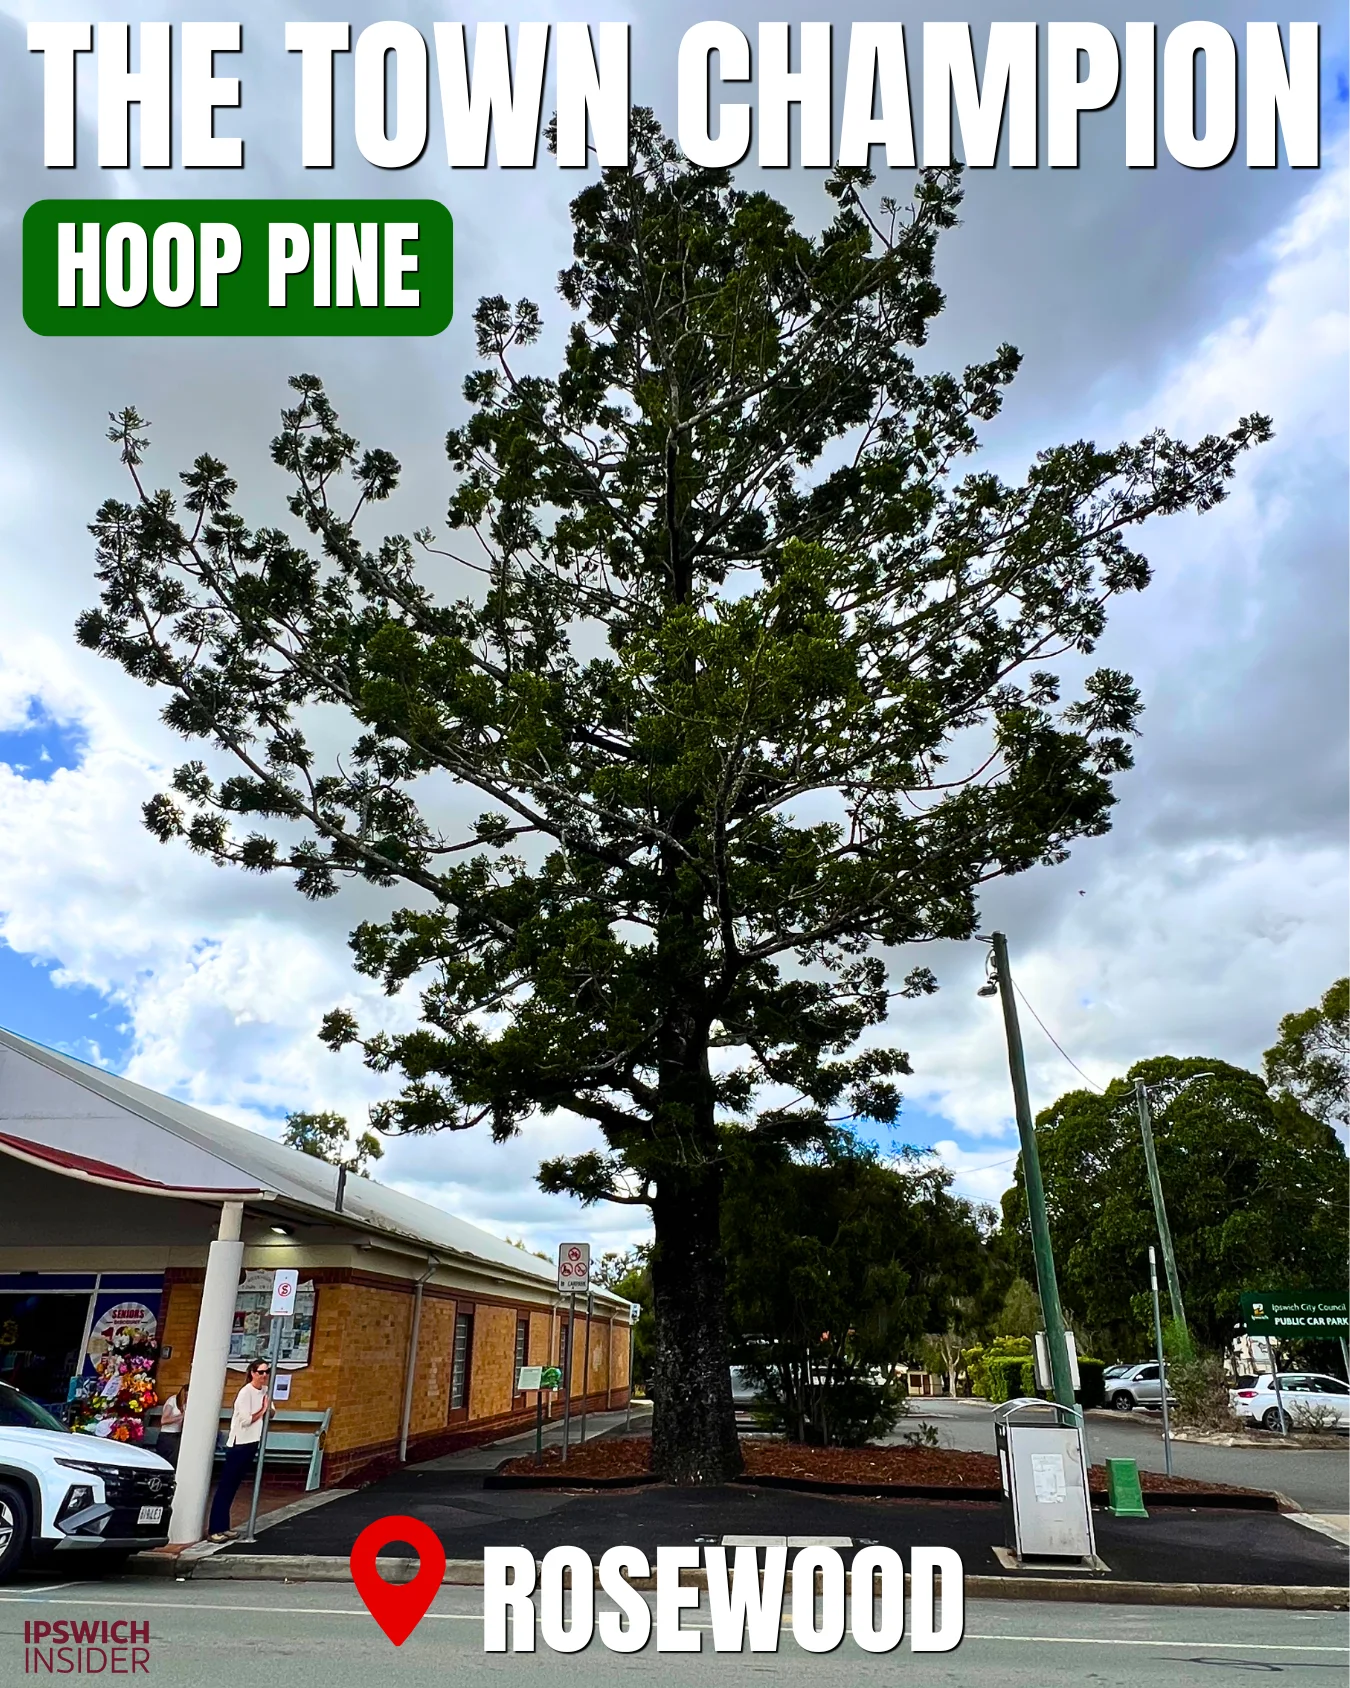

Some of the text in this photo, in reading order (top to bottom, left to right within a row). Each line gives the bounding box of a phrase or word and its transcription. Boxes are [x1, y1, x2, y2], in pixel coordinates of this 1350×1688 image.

[1272, 1303, 1347, 1313] Ipswich City Council
[112, 1309, 145, 1319] SENIORS
[1274, 1317, 1349, 1326] PUBLIC CAR PARK
